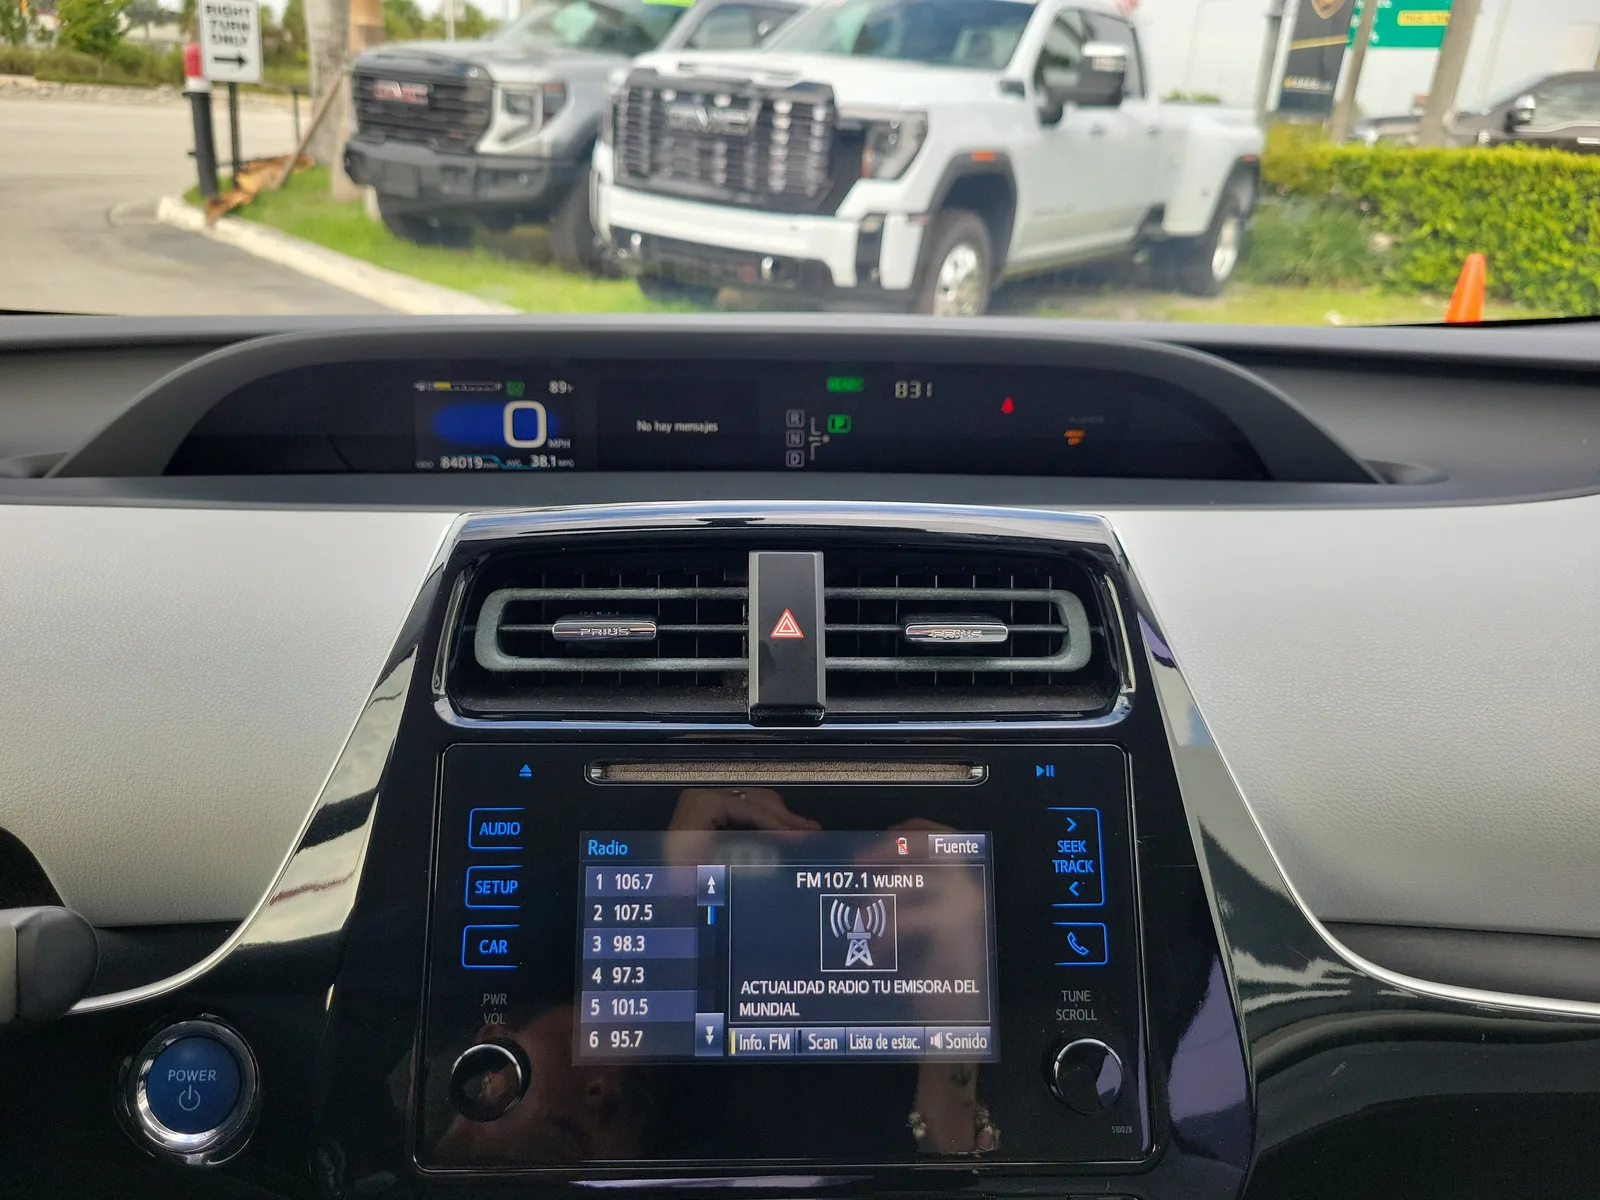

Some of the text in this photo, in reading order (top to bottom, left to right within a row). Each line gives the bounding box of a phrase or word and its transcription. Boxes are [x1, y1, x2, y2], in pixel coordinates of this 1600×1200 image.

[503, 400, 547, 448] 0
[636, 420, 719, 434] No hay mensajes
[439, 455, 483, 470] 84019
[529, 454, 557, 468] 38.1
[479, 821, 521, 836] AUDIO
[587, 839, 629, 857] Radio
[934, 838, 979, 854] Fuente
[1057, 840, 1087, 853] SEEK
[1052, 859, 1094, 873] TRACK
[475, 880, 518, 895] SETUP
[595, 873, 654, 890] 1 106.7
[873, 874, 912, 888] WURN
[915, 874, 924, 888] B
[593, 904, 653, 921] 2 107.5
[479, 940, 508, 953] CAR
[592, 935, 645, 952] 3 98.3
[591, 966, 645, 983] 4 97.3
[740, 979, 980, 995] ACTUALIDAD RADIO TU EMISORA DEL
[483, 993, 508, 1005] PWR
[1061, 990, 1091, 1003] TUNE
[590, 998, 648, 1016] 5 101.5
[739, 1002, 801, 1017] MUNDIAL
[483, 1012, 506, 1024] VOL
[1055, 1009, 1098, 1021] SCROLL
[589, 1030, 644, 1048] 6 95.7
[738, 1034, 790, 1050] Info. FM
[808, 1034, 838, 1050] Scan
[849, 1033, 921, 1049] Lista de estac.
[945, 1033, 988, 1049] Sonido
[167, 1069, 217, 1082] POWER
